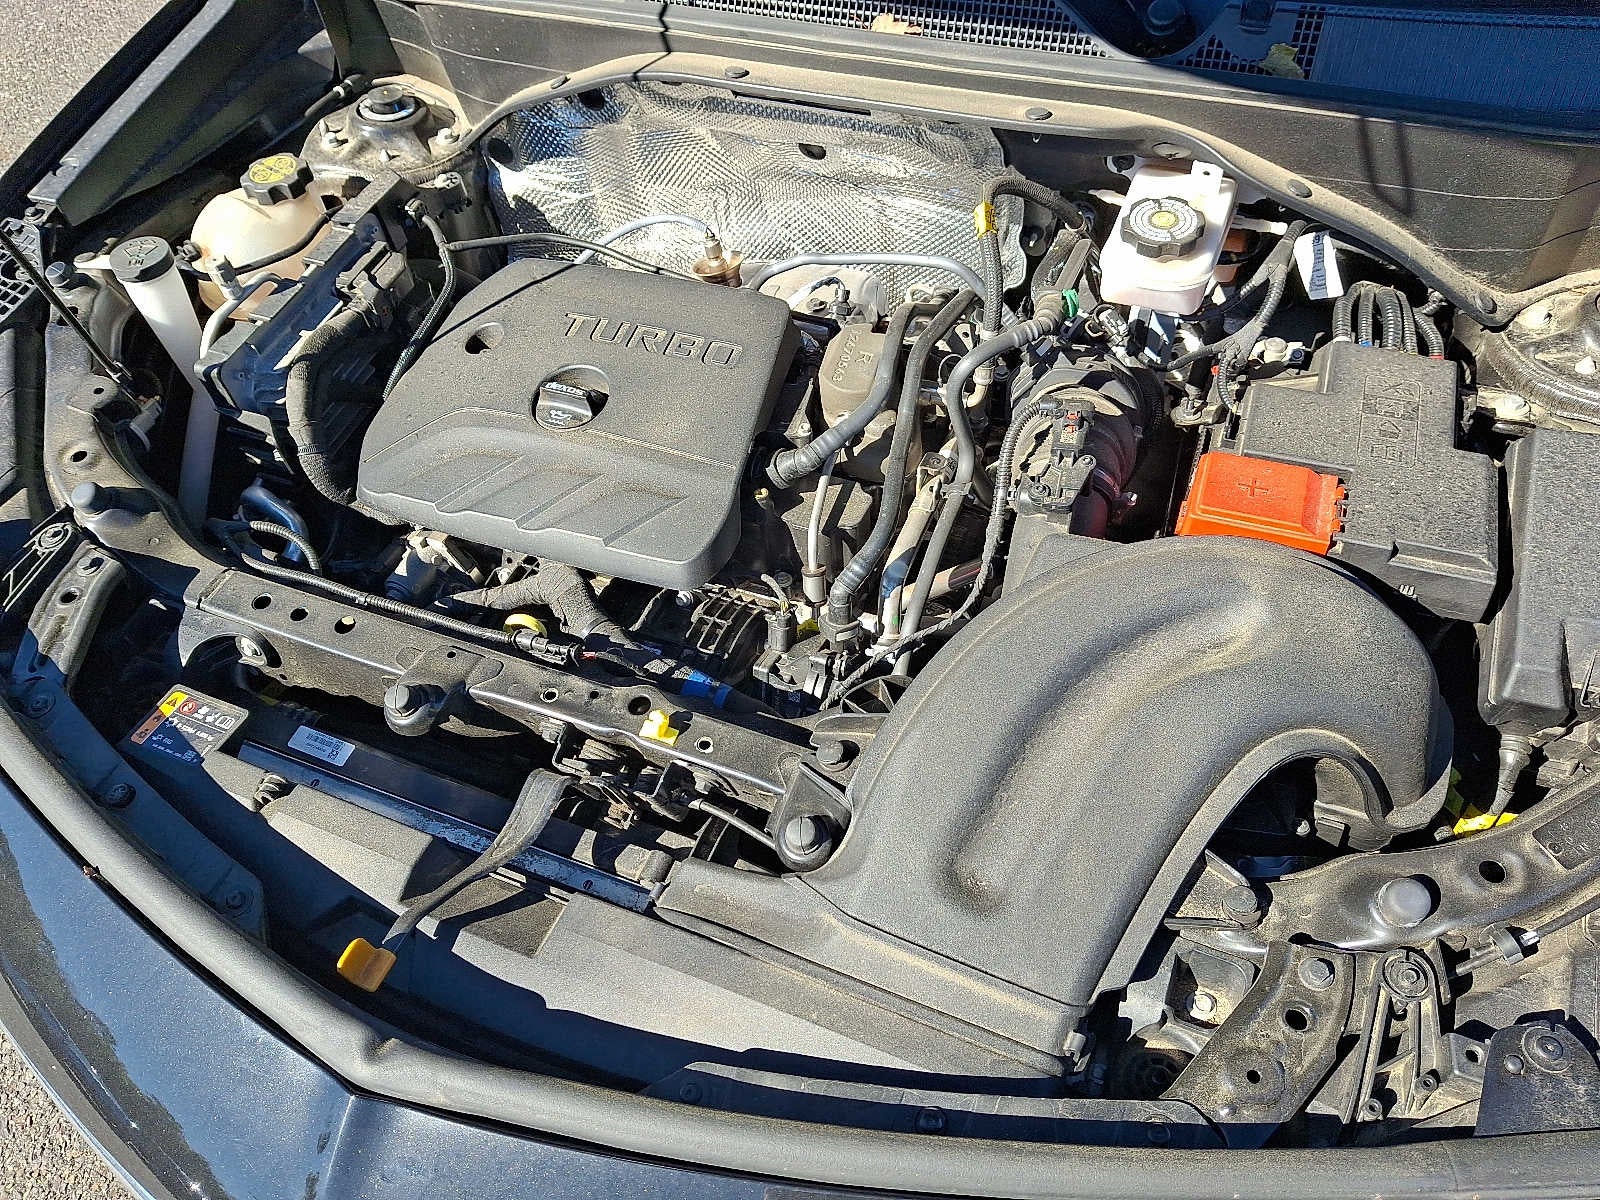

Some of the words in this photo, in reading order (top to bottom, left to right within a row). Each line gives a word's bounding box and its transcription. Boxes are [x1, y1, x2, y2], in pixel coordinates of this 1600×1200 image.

[564, 312, 744, 366] TURBO
[855, 351, 873, 364] R
[544, 381, 585, 397] dexos
